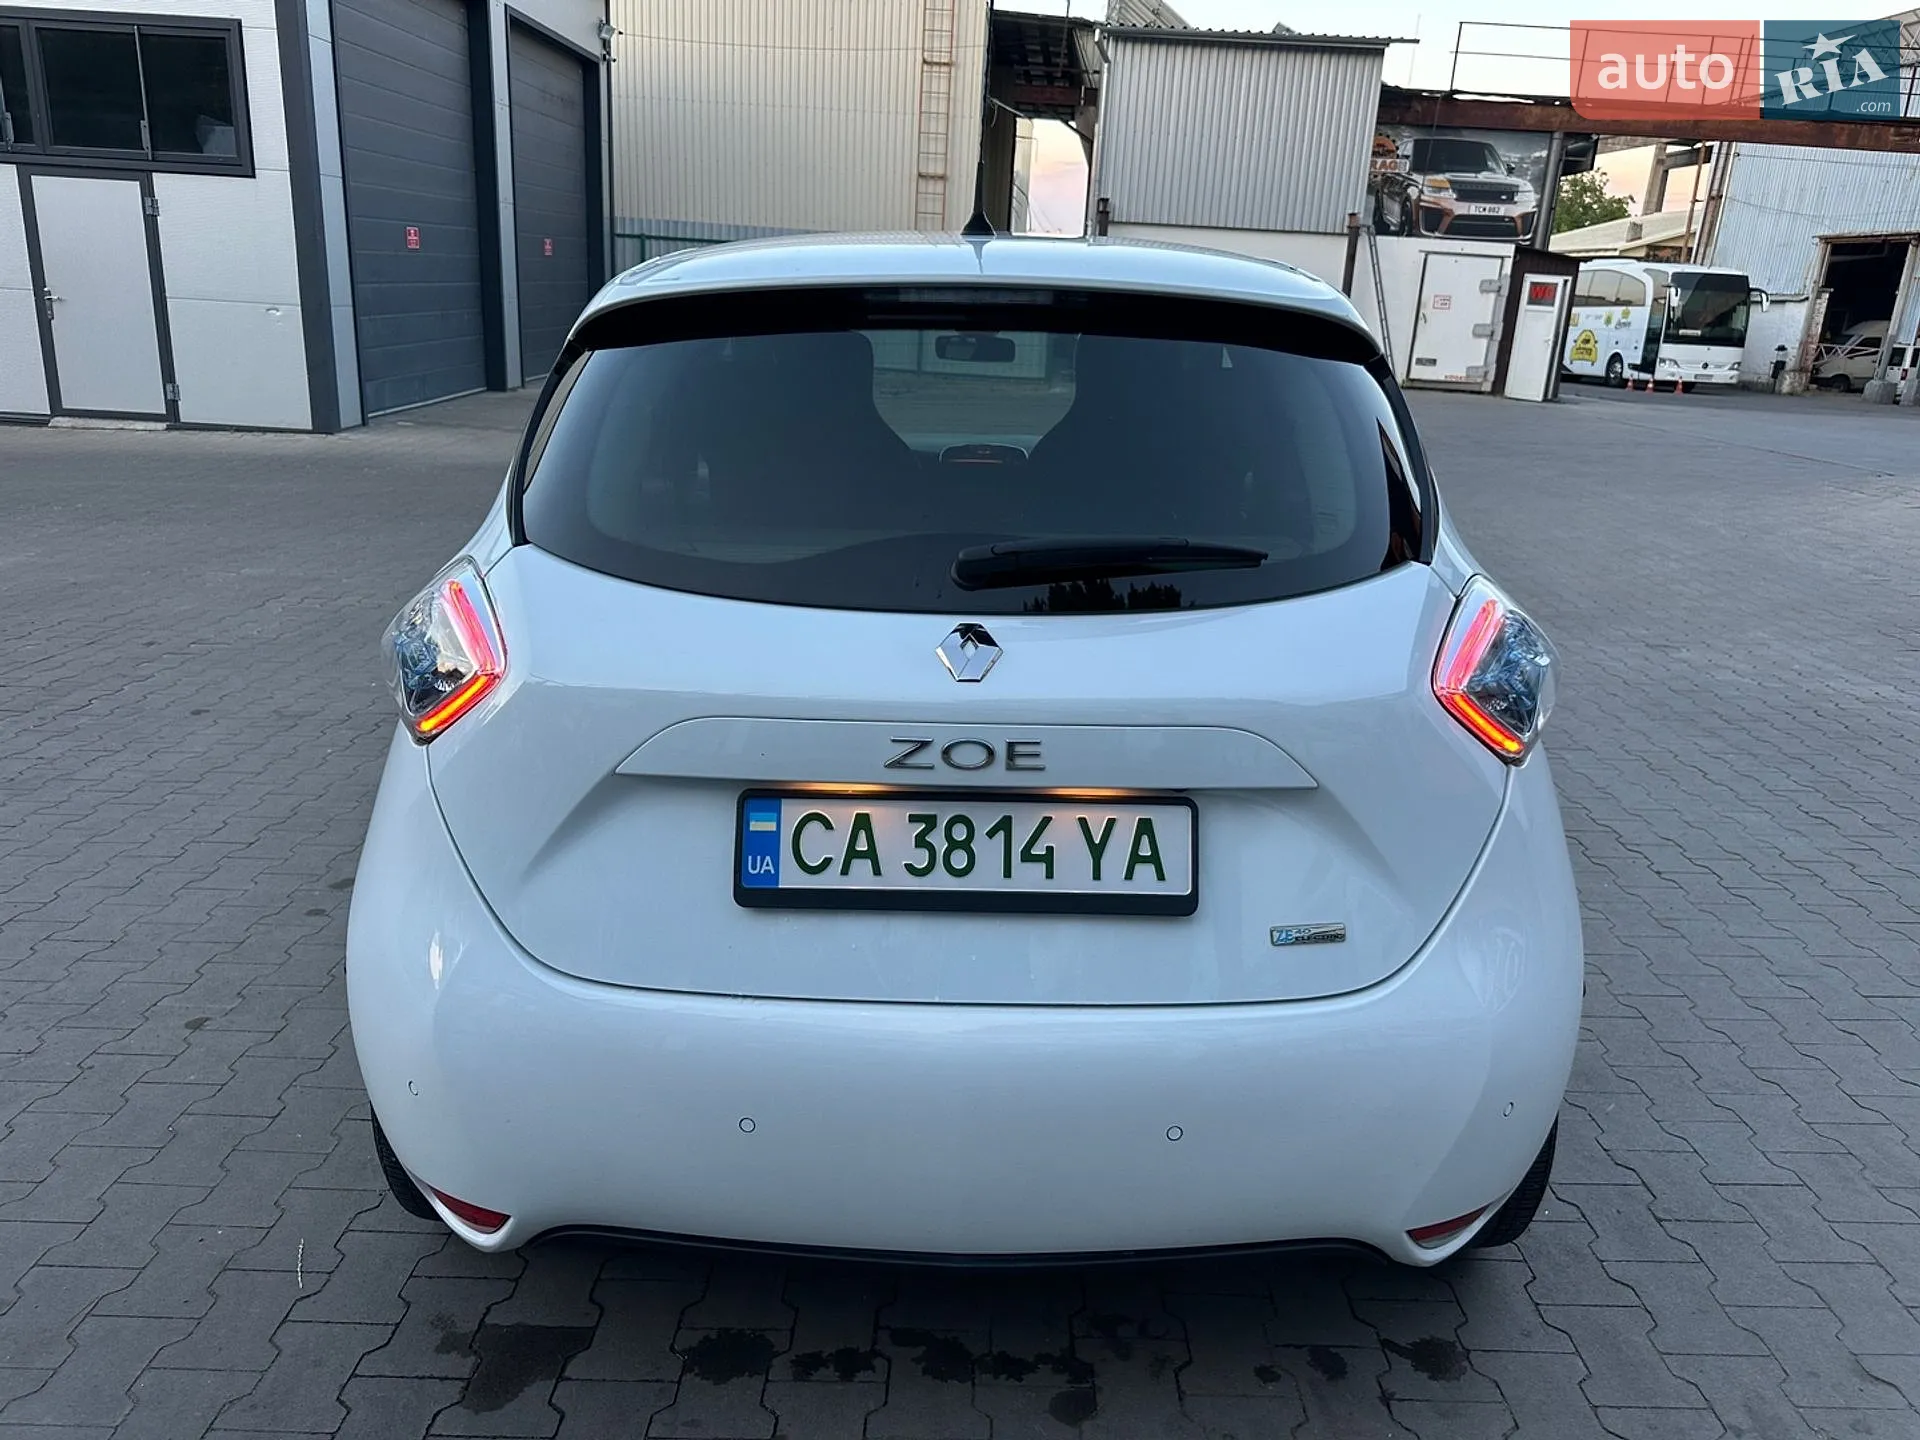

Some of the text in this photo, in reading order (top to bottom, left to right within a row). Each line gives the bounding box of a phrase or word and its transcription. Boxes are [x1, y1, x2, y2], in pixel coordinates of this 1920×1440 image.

[883, 736, 1046, 771] ZOE
[791, 810, 1167, 881] CA 3814 YA
[747, 856, 775, 875] UA
